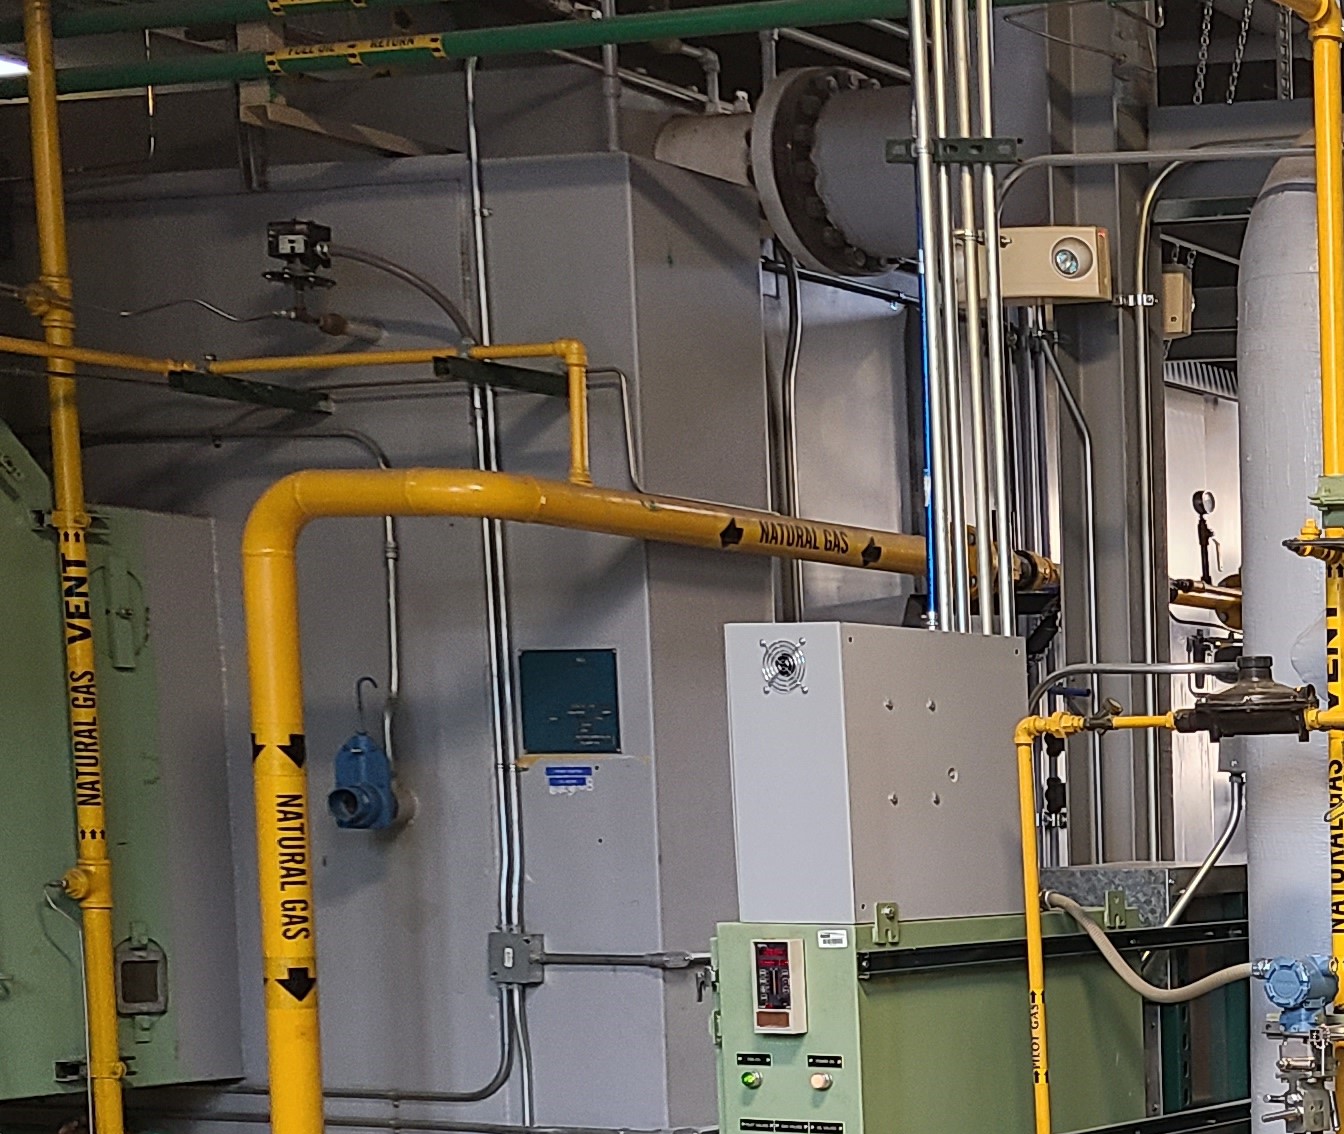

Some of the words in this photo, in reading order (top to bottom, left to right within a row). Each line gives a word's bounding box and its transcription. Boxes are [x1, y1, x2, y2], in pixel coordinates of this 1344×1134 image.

[759, 520, 820, 550] NATURAL
[823, 530, 849, 554] GAS
[62, 552, 92, 646] VENT
[69, 668, 97, 715] GAS
[74, 716, 103, 807] NATURAL
[275, 794, 309, 892] NATURAL
[280, 899, 312, 941] GAS
[1030, 1004, 1039, 1030] GAS
